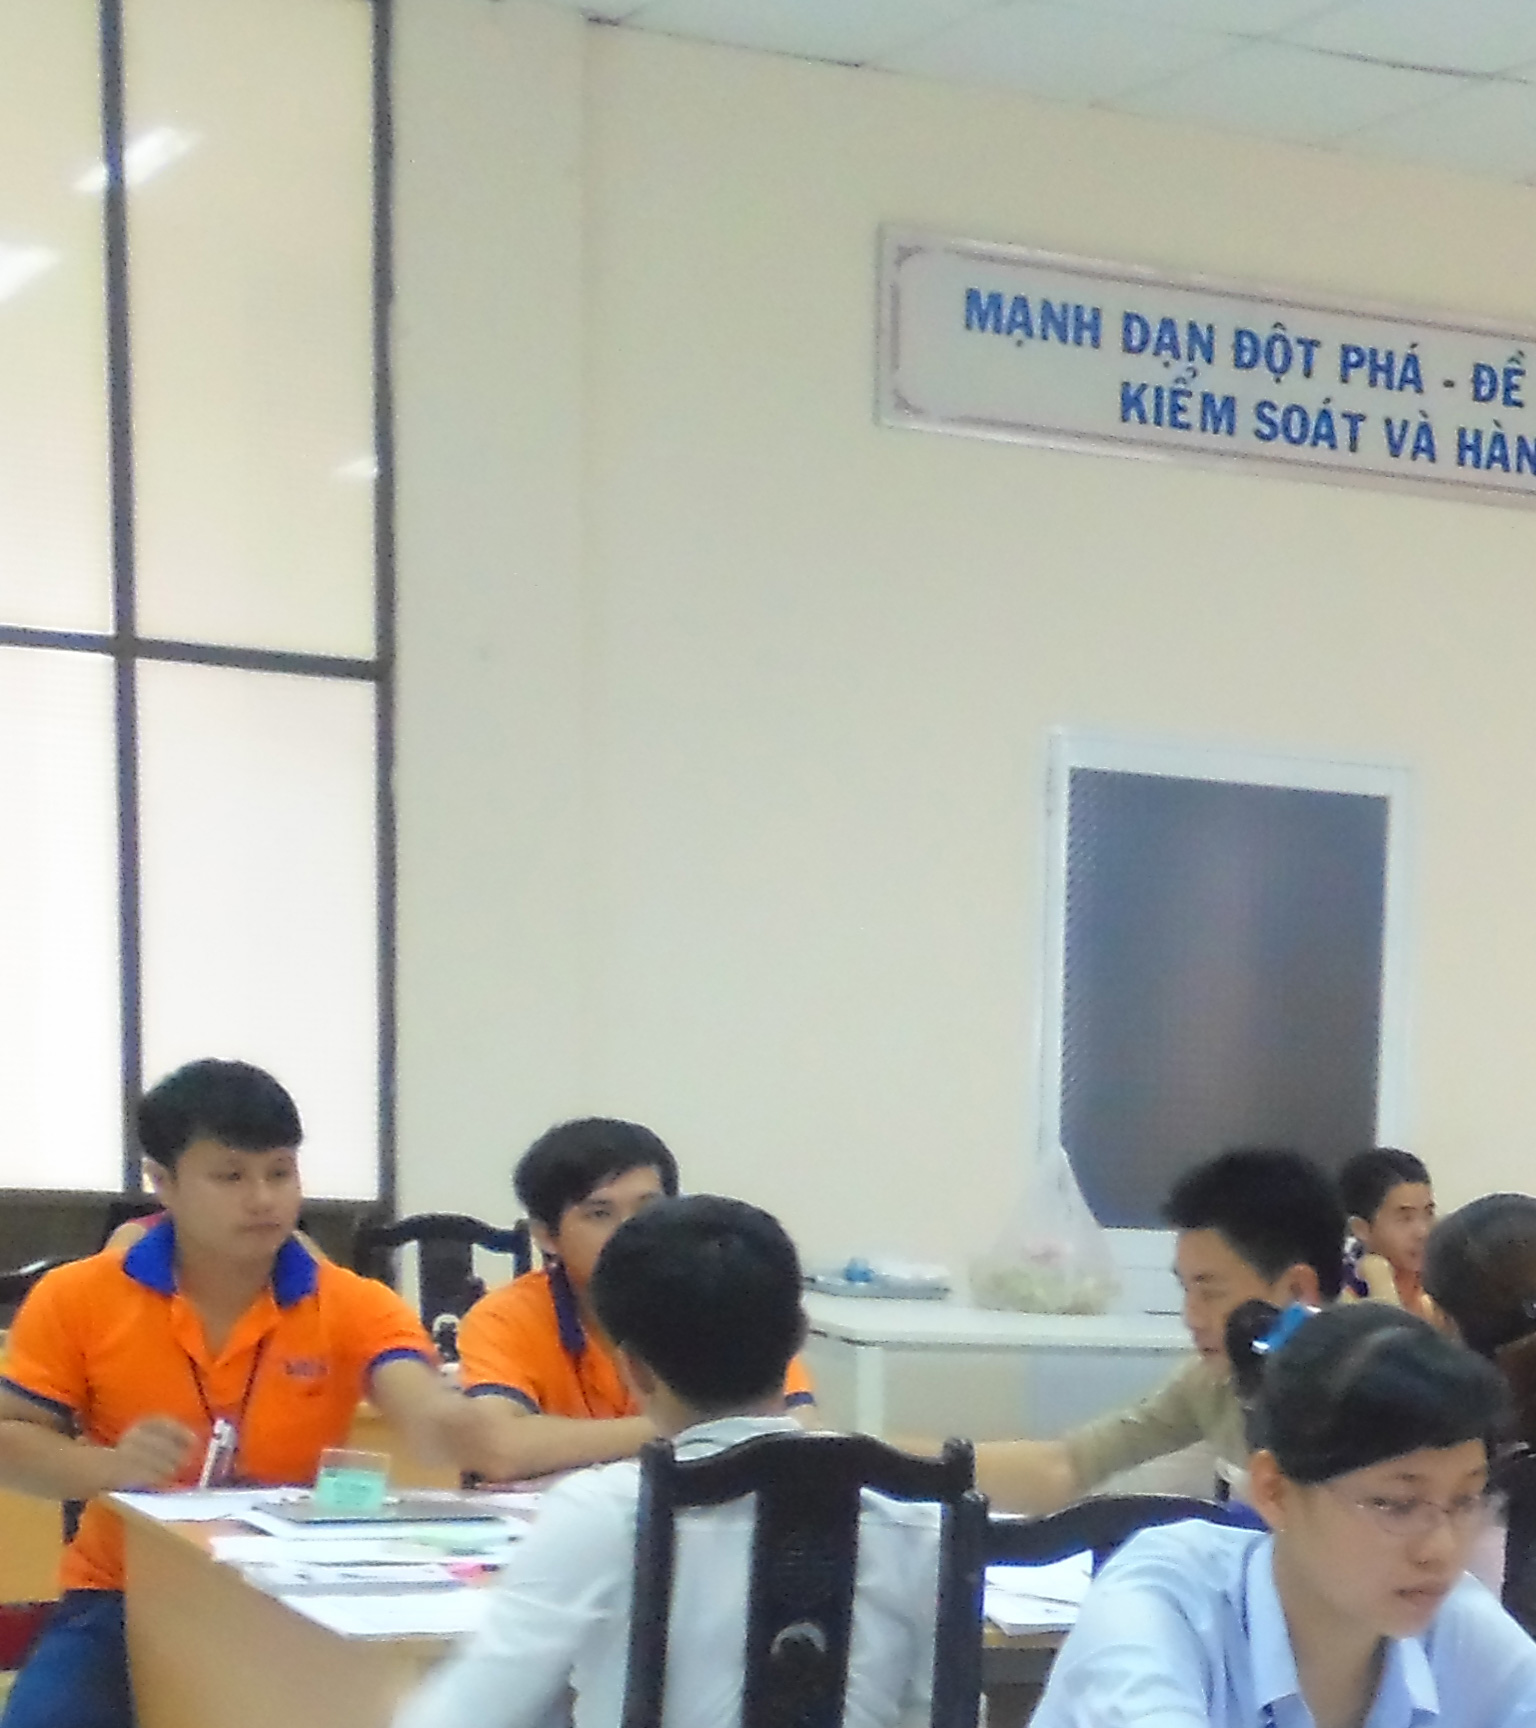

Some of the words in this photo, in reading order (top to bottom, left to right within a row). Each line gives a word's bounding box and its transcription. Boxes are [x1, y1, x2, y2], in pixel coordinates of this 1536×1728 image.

[965, 288, 1101, 349] MẠNH
[1122, 311, 1215, 368] DẠN
[1233, 322, 1321, 383] ĐỘT
[1340, 342, 1424, 393] PHÁ
[1472, 350, 1525, 408] ĐỀ
[1121, 367, 1236, 436] KIỂM
[1254, 397, 1366, 452] SOÁT
[1384, 410, 1436, 463] VÀ
